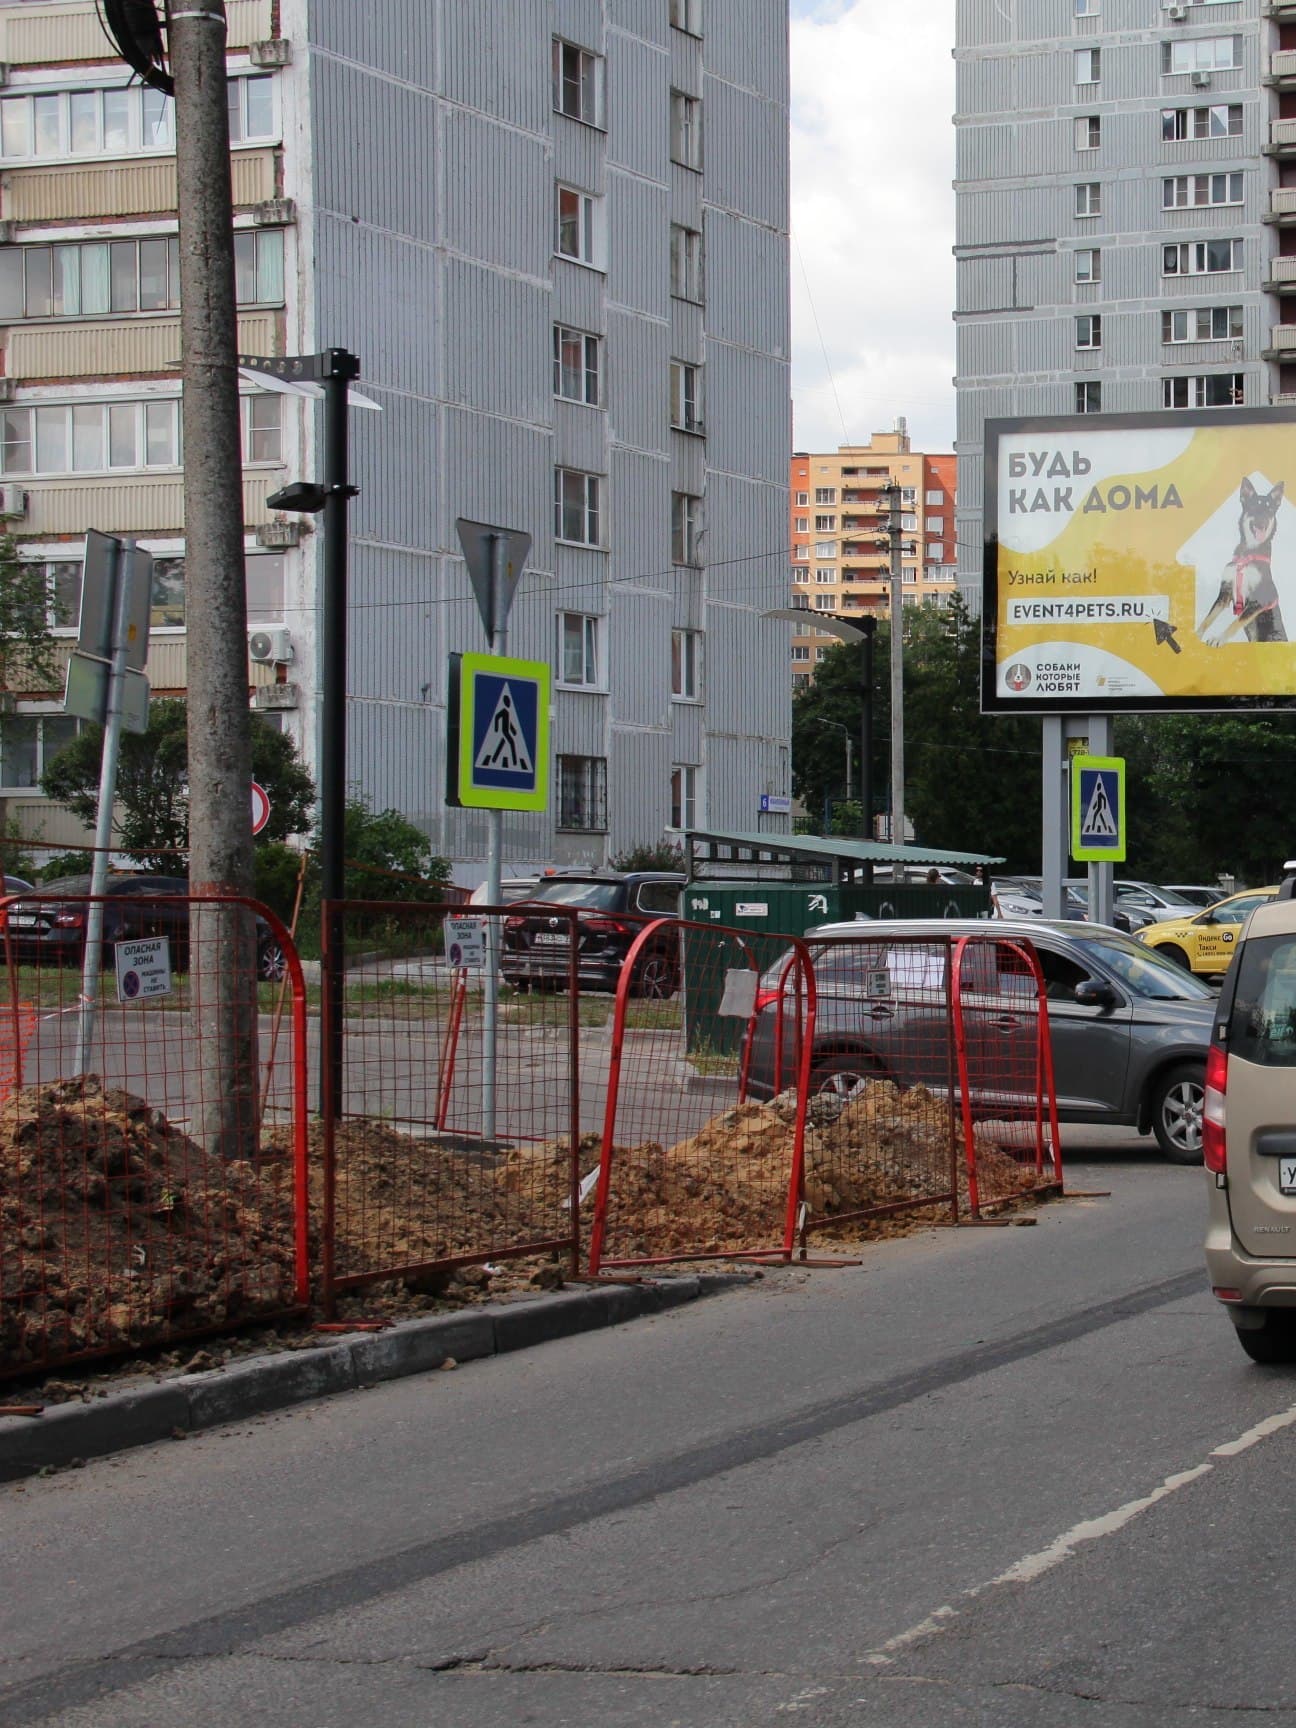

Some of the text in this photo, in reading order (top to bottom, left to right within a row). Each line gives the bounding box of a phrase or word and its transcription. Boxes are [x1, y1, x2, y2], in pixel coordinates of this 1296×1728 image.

[1008, 451, 1091, 478] БУДЬ
[1009, 483, 1183, 513] КАК ДОМА
[1008, 568, 1097, 585] Узнай как!
[1014, 603, 1144, 618] EVENT4PETS.RU
[1036, 663, 1081, 671] СОБАКИ
[1036, 673, 1081, 681] КОТОРЫЕ
[1036, 682, 1080, 692] ЛЮБЯТ
[762, 798, 768, 810] 6
[1198, 934, 1222, 943] Яндекс
[124, 942, 162, 956] ОПАСНАЯ
[1199, 943, 1217, 951] Такси
[132, 955, 154, 967] ЗОНА
